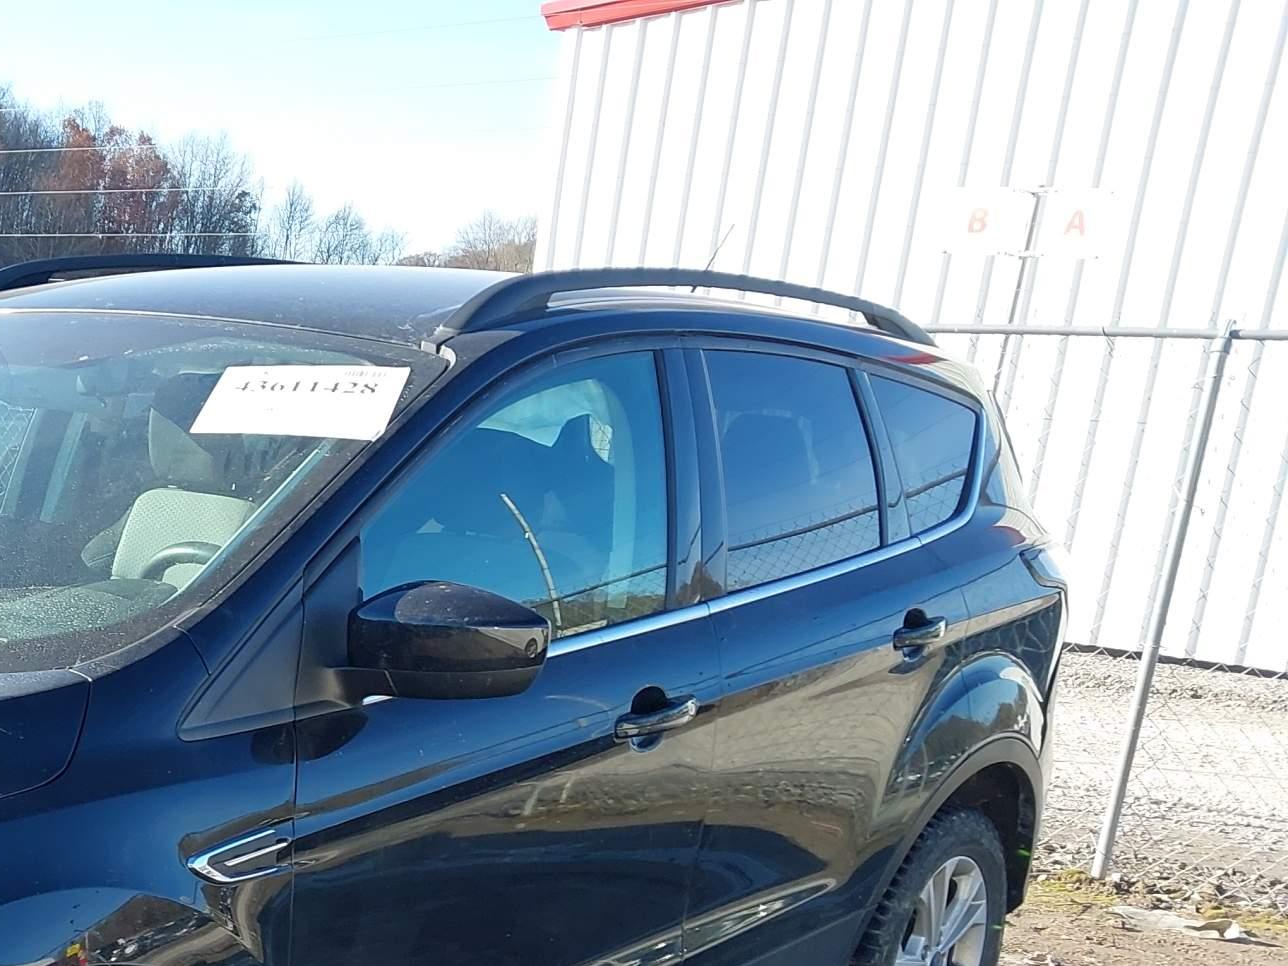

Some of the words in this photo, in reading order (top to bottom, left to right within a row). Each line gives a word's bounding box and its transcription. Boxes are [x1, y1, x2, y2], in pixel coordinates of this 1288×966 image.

[967, 207, 988, 234] B
[1064, 208, 1086, 237] A
[235, 380, 379, 394] 43611428
